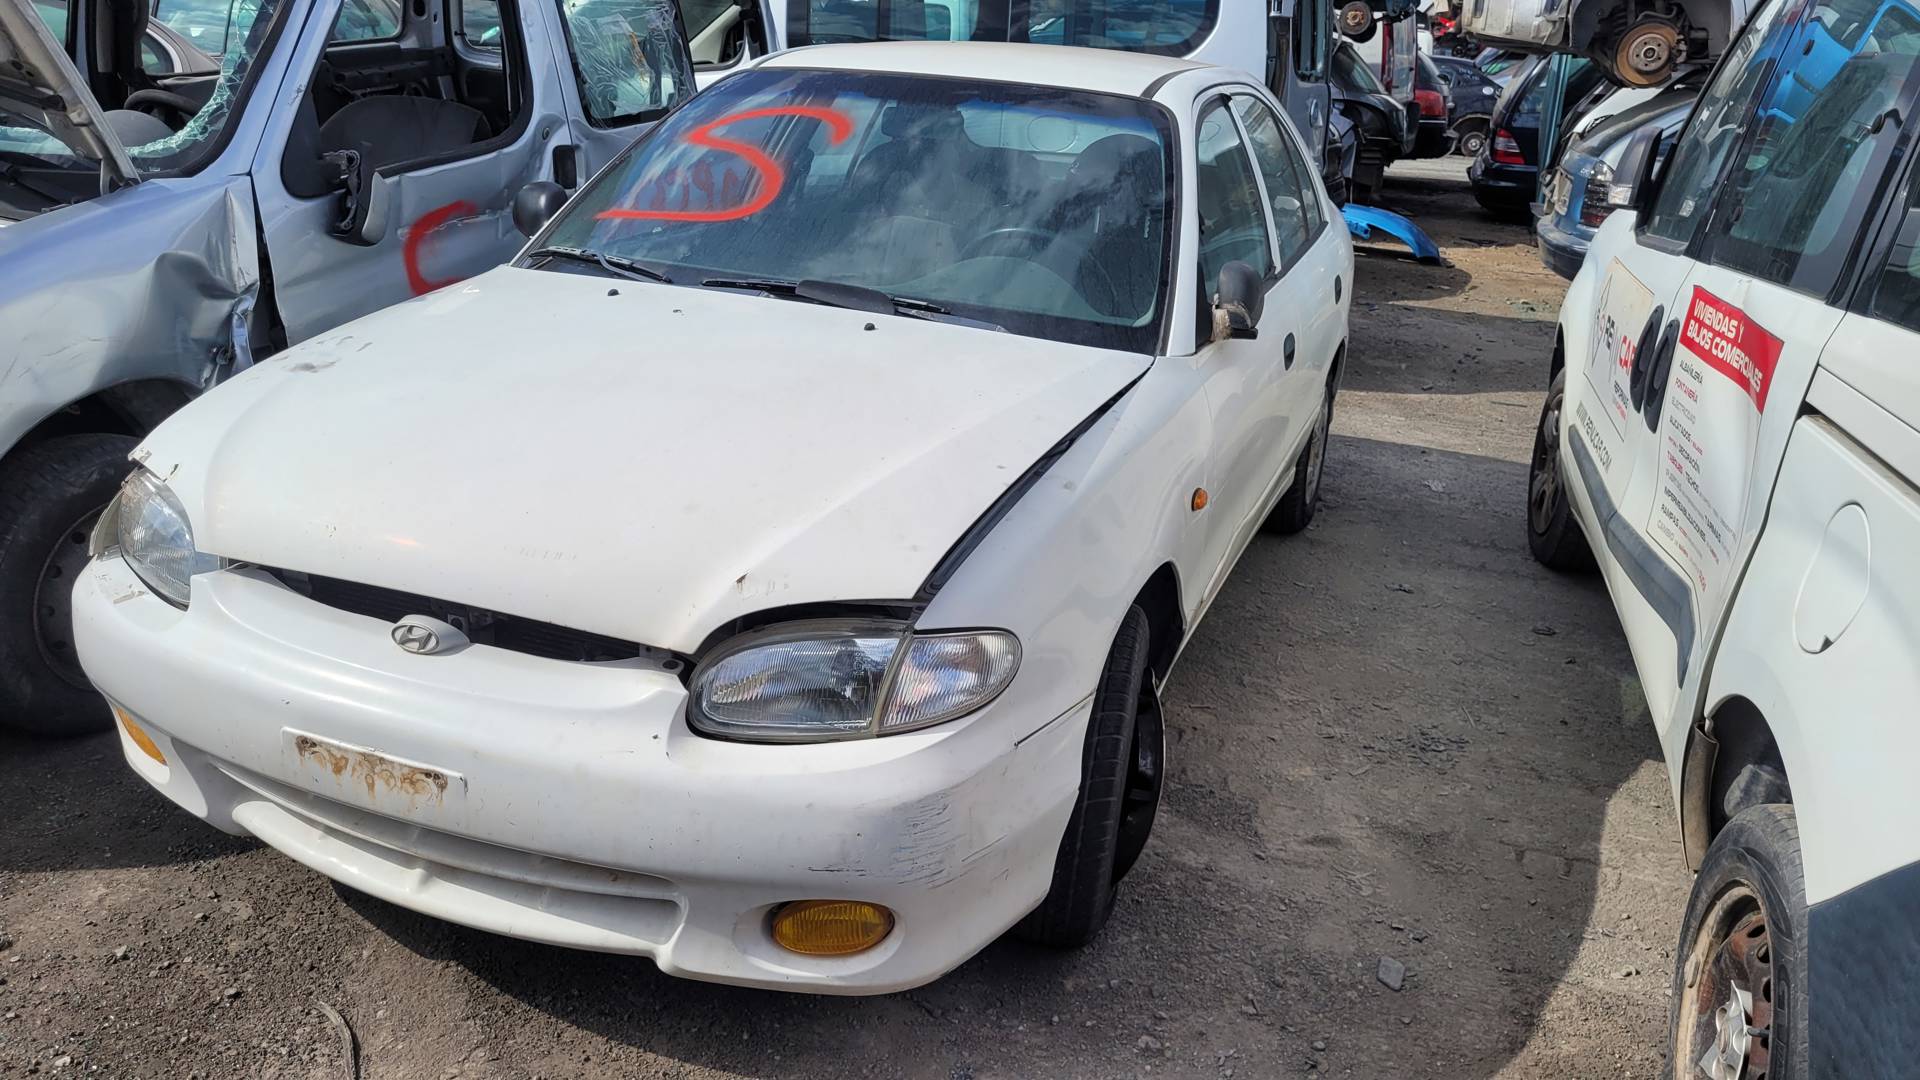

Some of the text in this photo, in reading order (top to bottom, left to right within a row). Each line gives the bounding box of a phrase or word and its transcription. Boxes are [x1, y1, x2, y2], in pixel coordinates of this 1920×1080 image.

[1693, 298, 1745, 344] VIVIENDAS Y
[1687, 319, 1763, 393] BAJOS COMERCIALES
